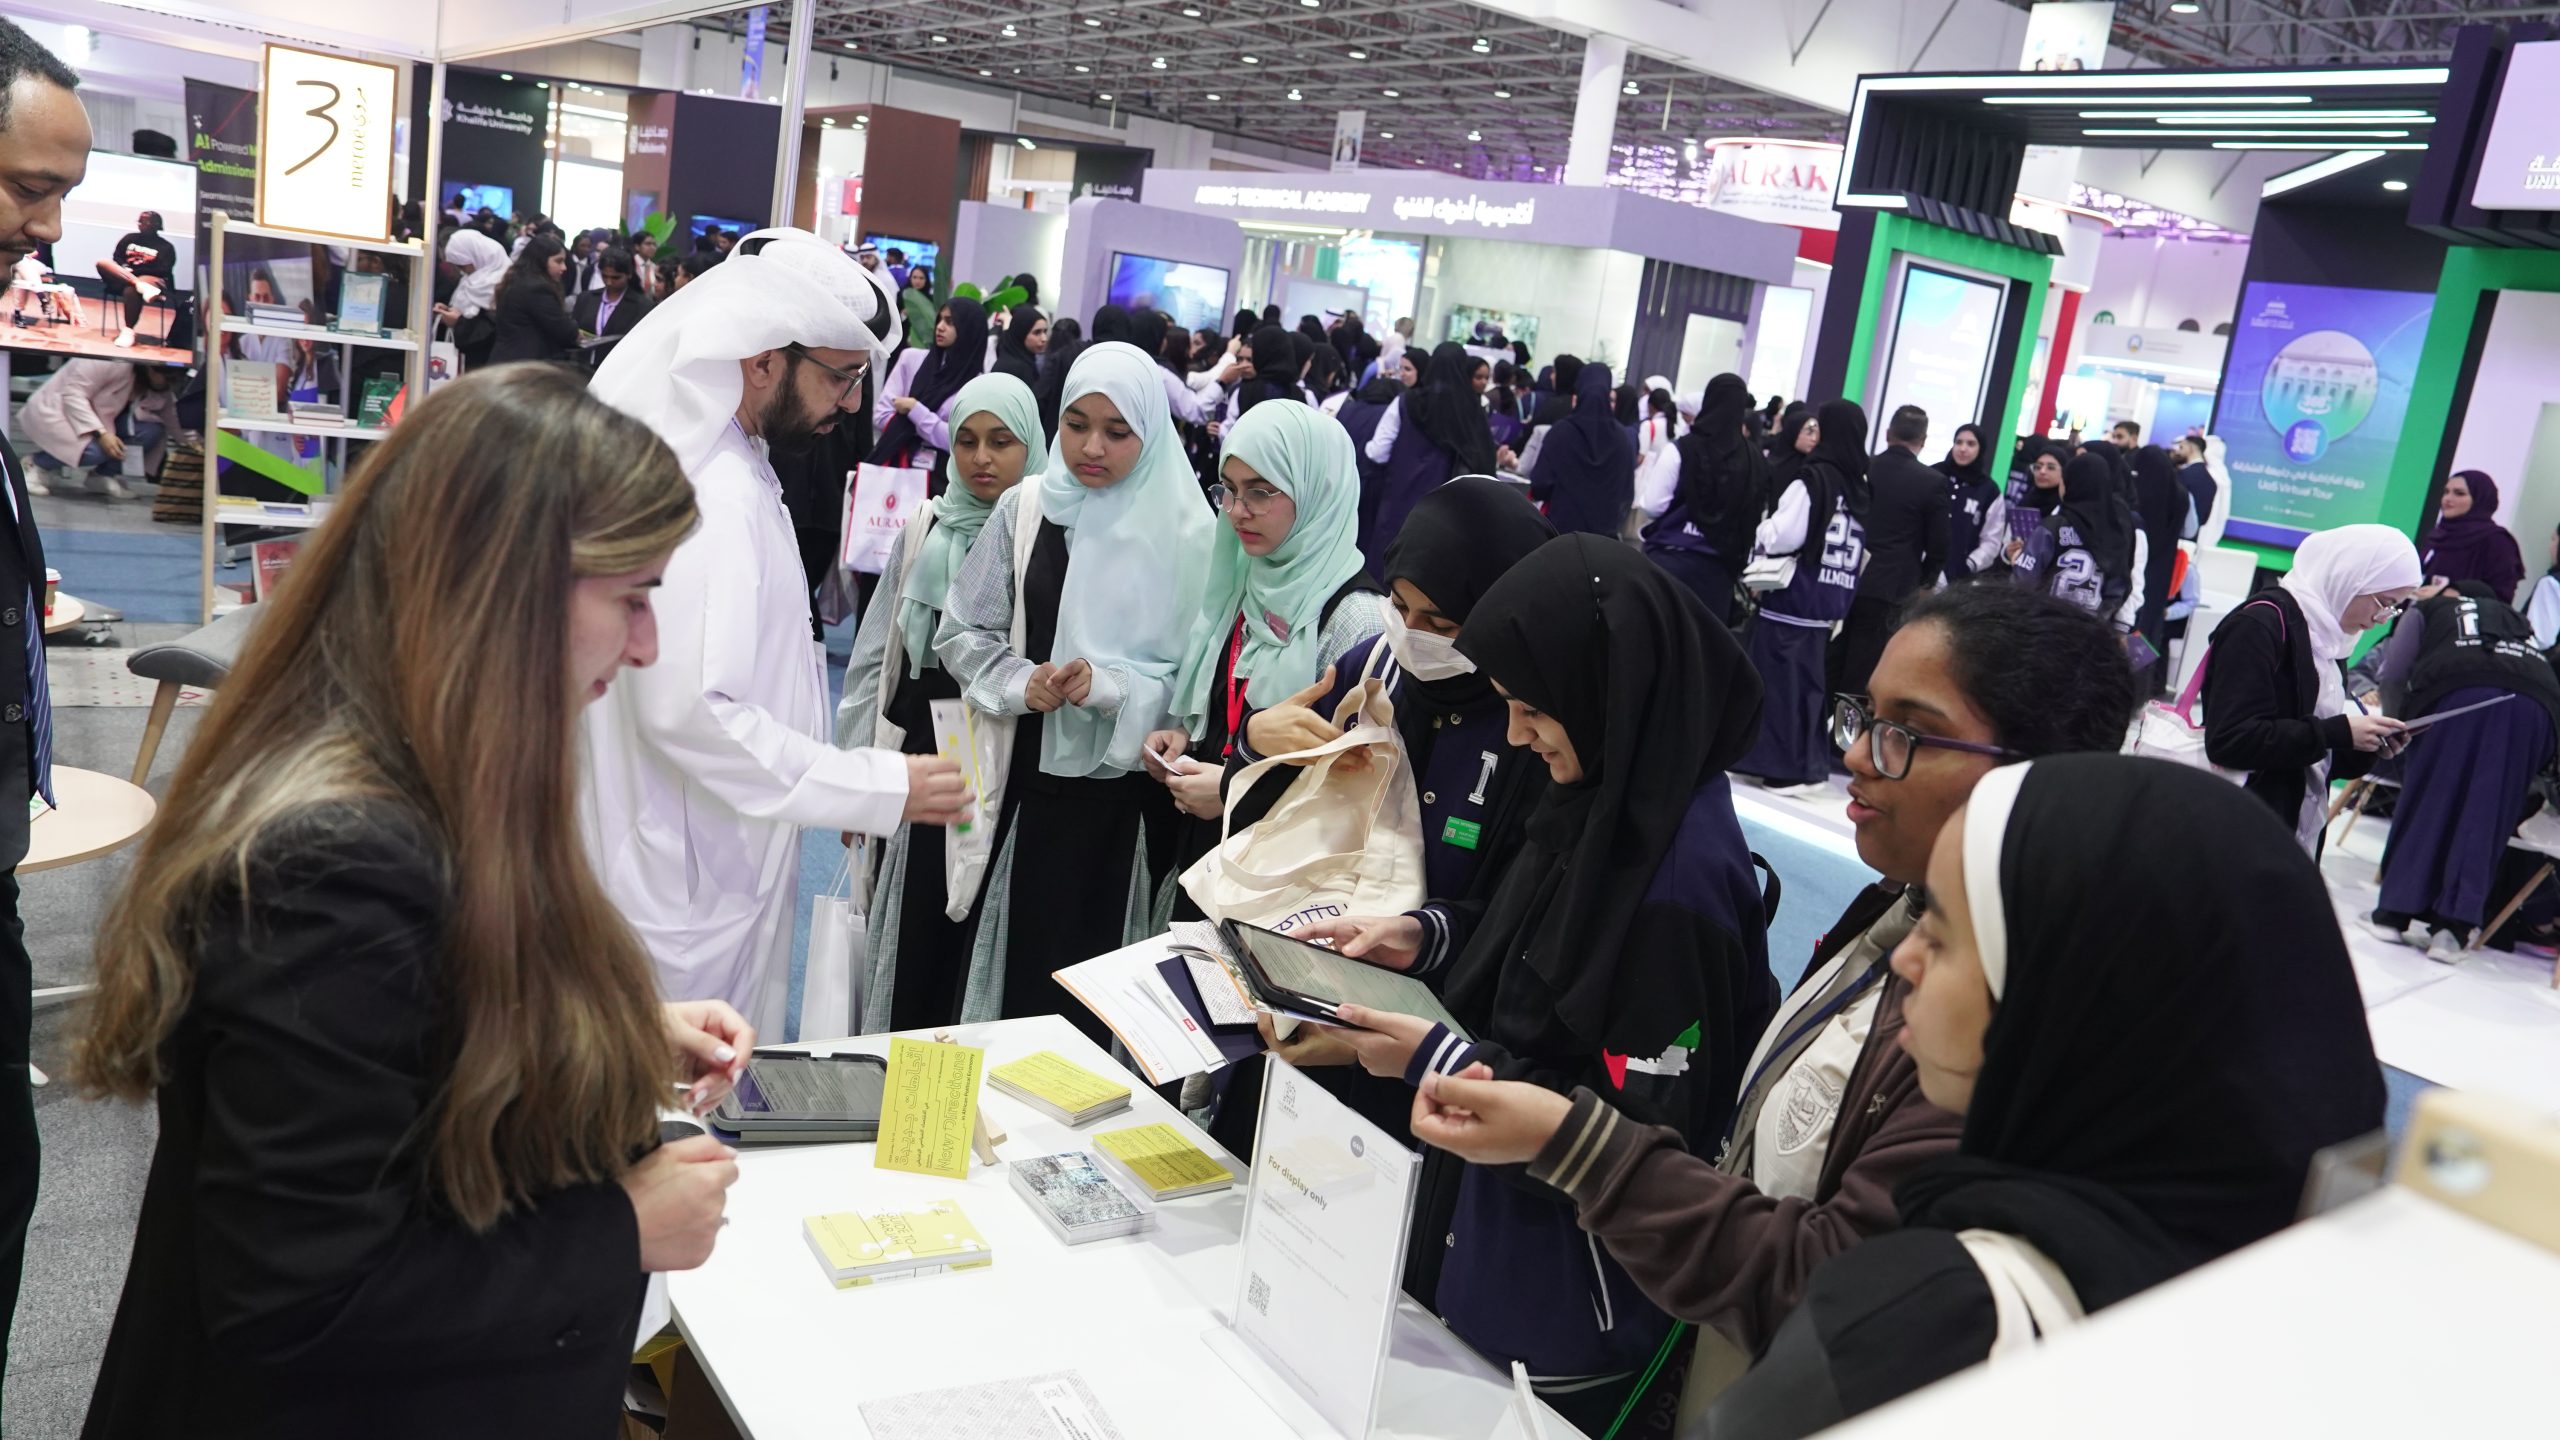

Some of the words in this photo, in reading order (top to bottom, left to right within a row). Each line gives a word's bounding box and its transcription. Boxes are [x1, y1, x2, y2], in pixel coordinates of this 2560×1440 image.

[456, 113, 488, 127] Khalifa
[489, 118, 532, 135] University
[1821, 512, 1864, 571] 25
[967, 1053, 976, 1077] Economy
[942, 1050, 966, 1131] Directions
[934, 1132, 960, 1172] New
[1267, 1155, 1281, 1173] For
[1281, 1166, 1309, 1197] display
[1310, 1191, 1328, 1211] only
[886, 1212, 910, 1234] GUIDE
[903, 1234, 917, 1245] TO
